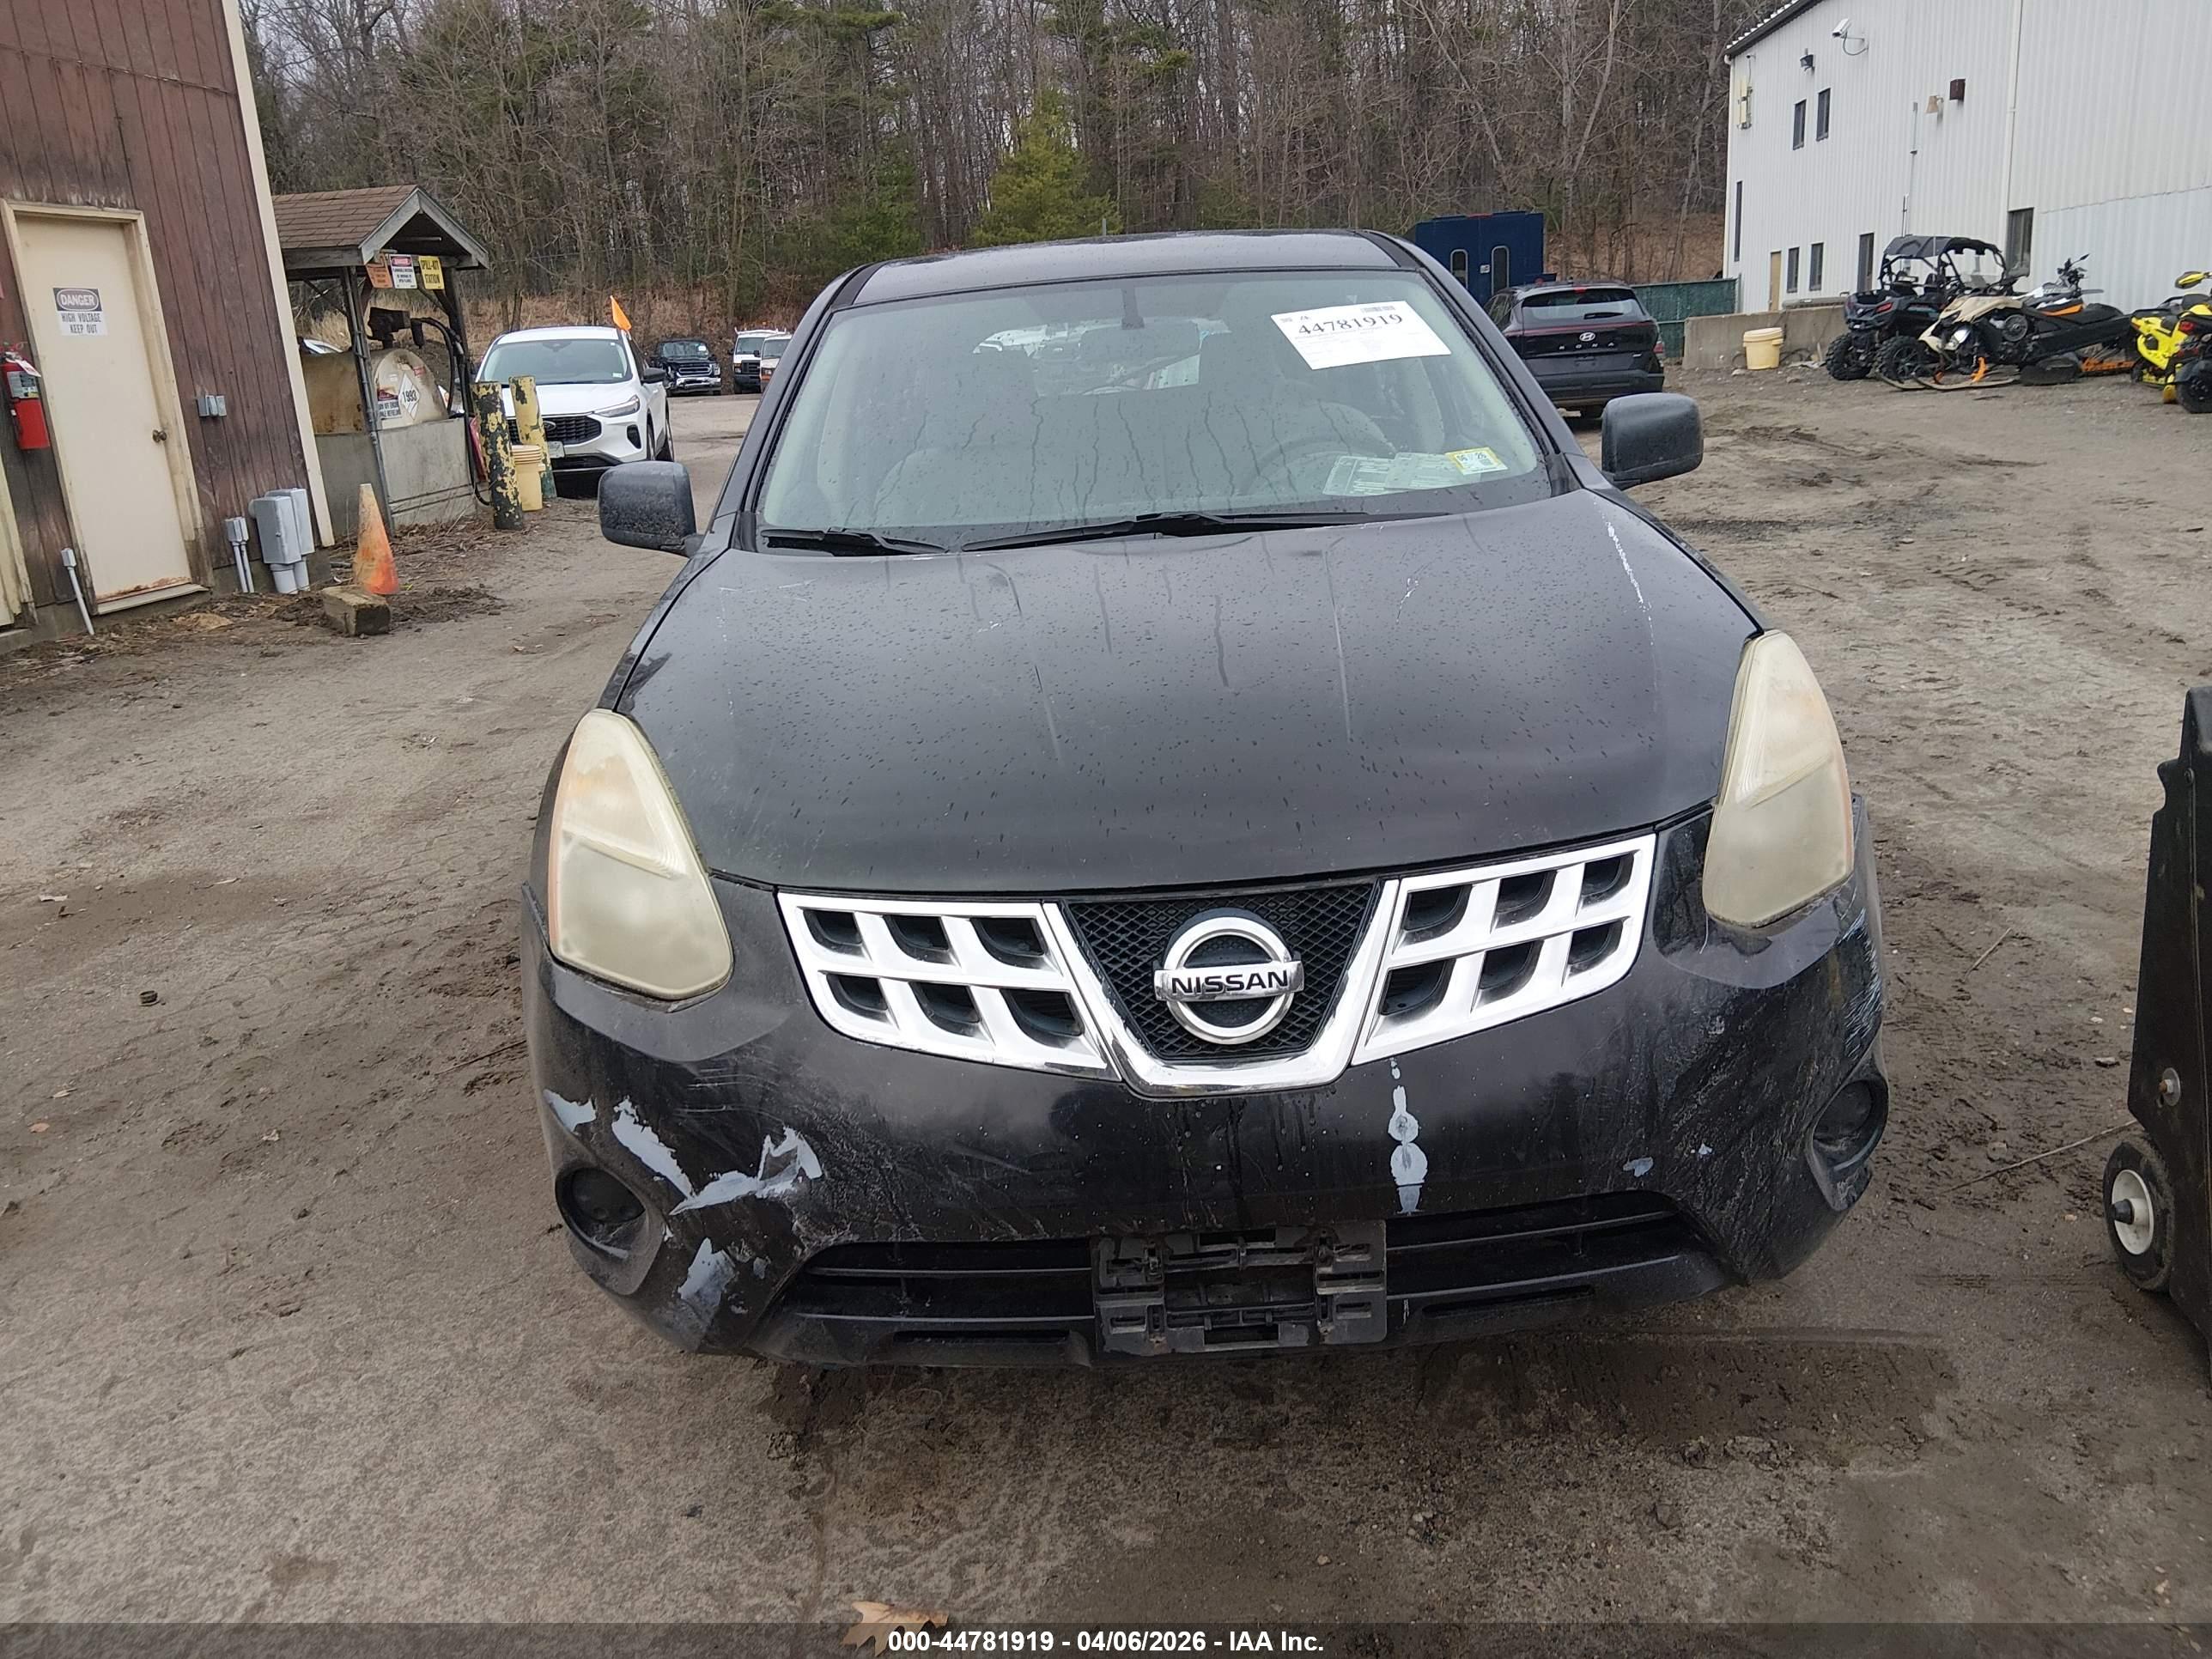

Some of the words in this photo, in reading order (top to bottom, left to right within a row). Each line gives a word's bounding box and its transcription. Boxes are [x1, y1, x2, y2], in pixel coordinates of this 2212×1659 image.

[424, 273, 441, 284] STATION
[60, 294, 95, 306] DANGER
[61, 313, 76, 323] HIGH
[77, 313, 101, 323] VOLTAGE
[70, 324, 84, 334] KEEP
[86, 324, 97, 334] OUT
[1297, 313, 1403, 336] 44781919
[402, 389, 417, 404] 1993
[1171, 969, 1289, 994] NISSAN
